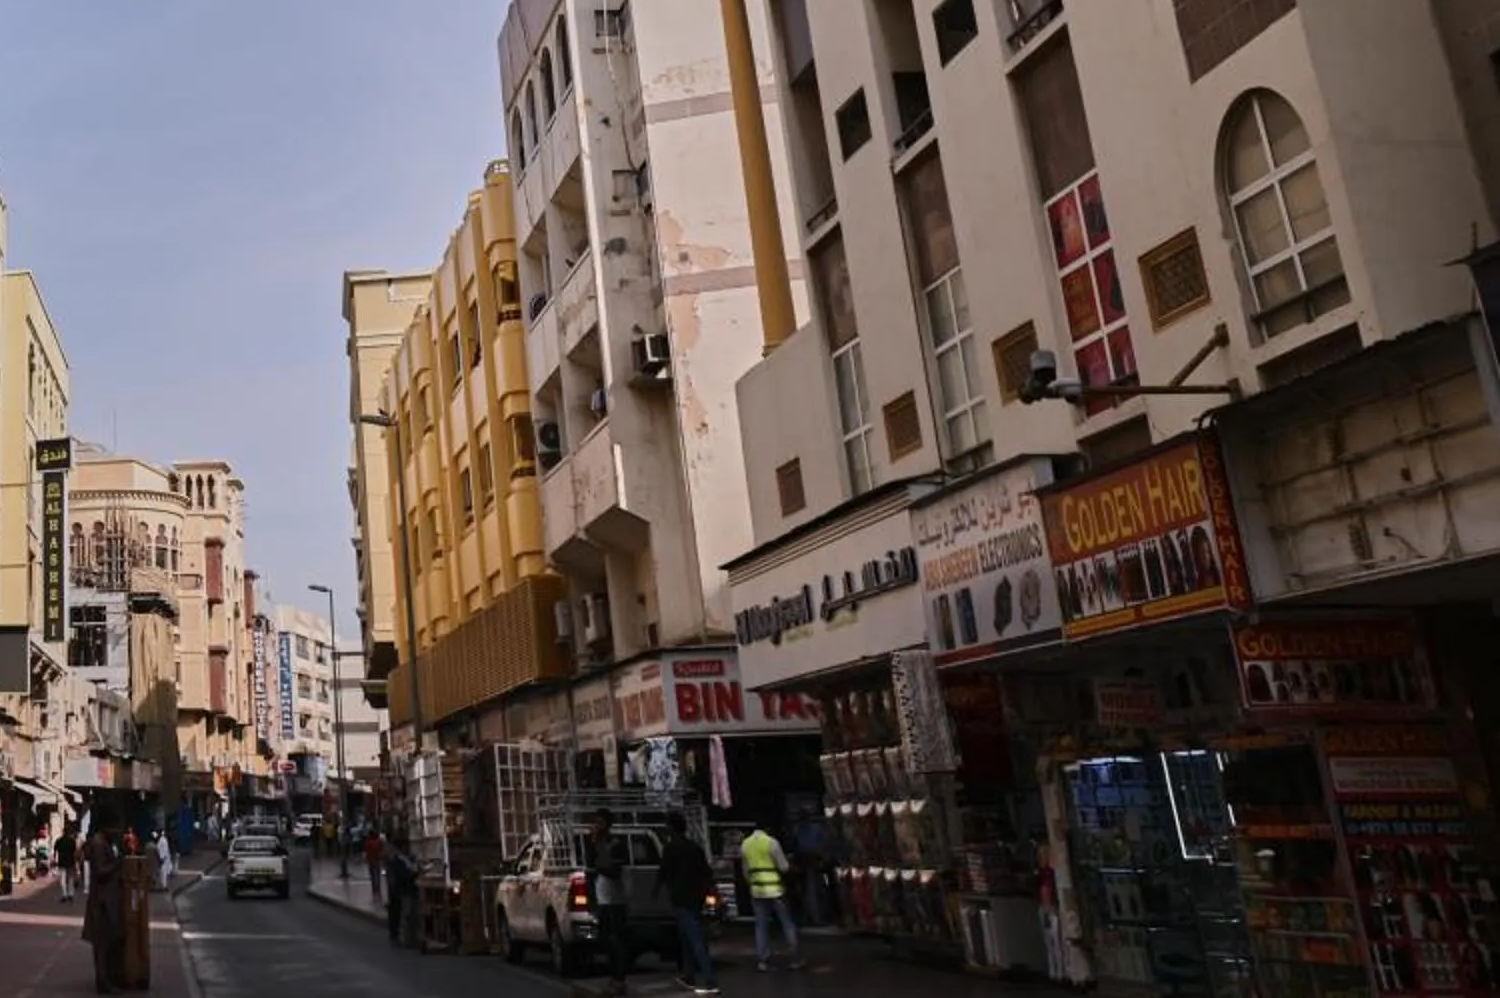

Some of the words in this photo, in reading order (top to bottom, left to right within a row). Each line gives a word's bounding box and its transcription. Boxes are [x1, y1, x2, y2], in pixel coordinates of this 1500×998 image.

[1062, 479, 1145, 554] GOLDEN
[1144, 459, 1204, 529] HAIR
[978, 521, 1043, 573] ELECTRONICS
[675, 682, 745, 723] BIN
